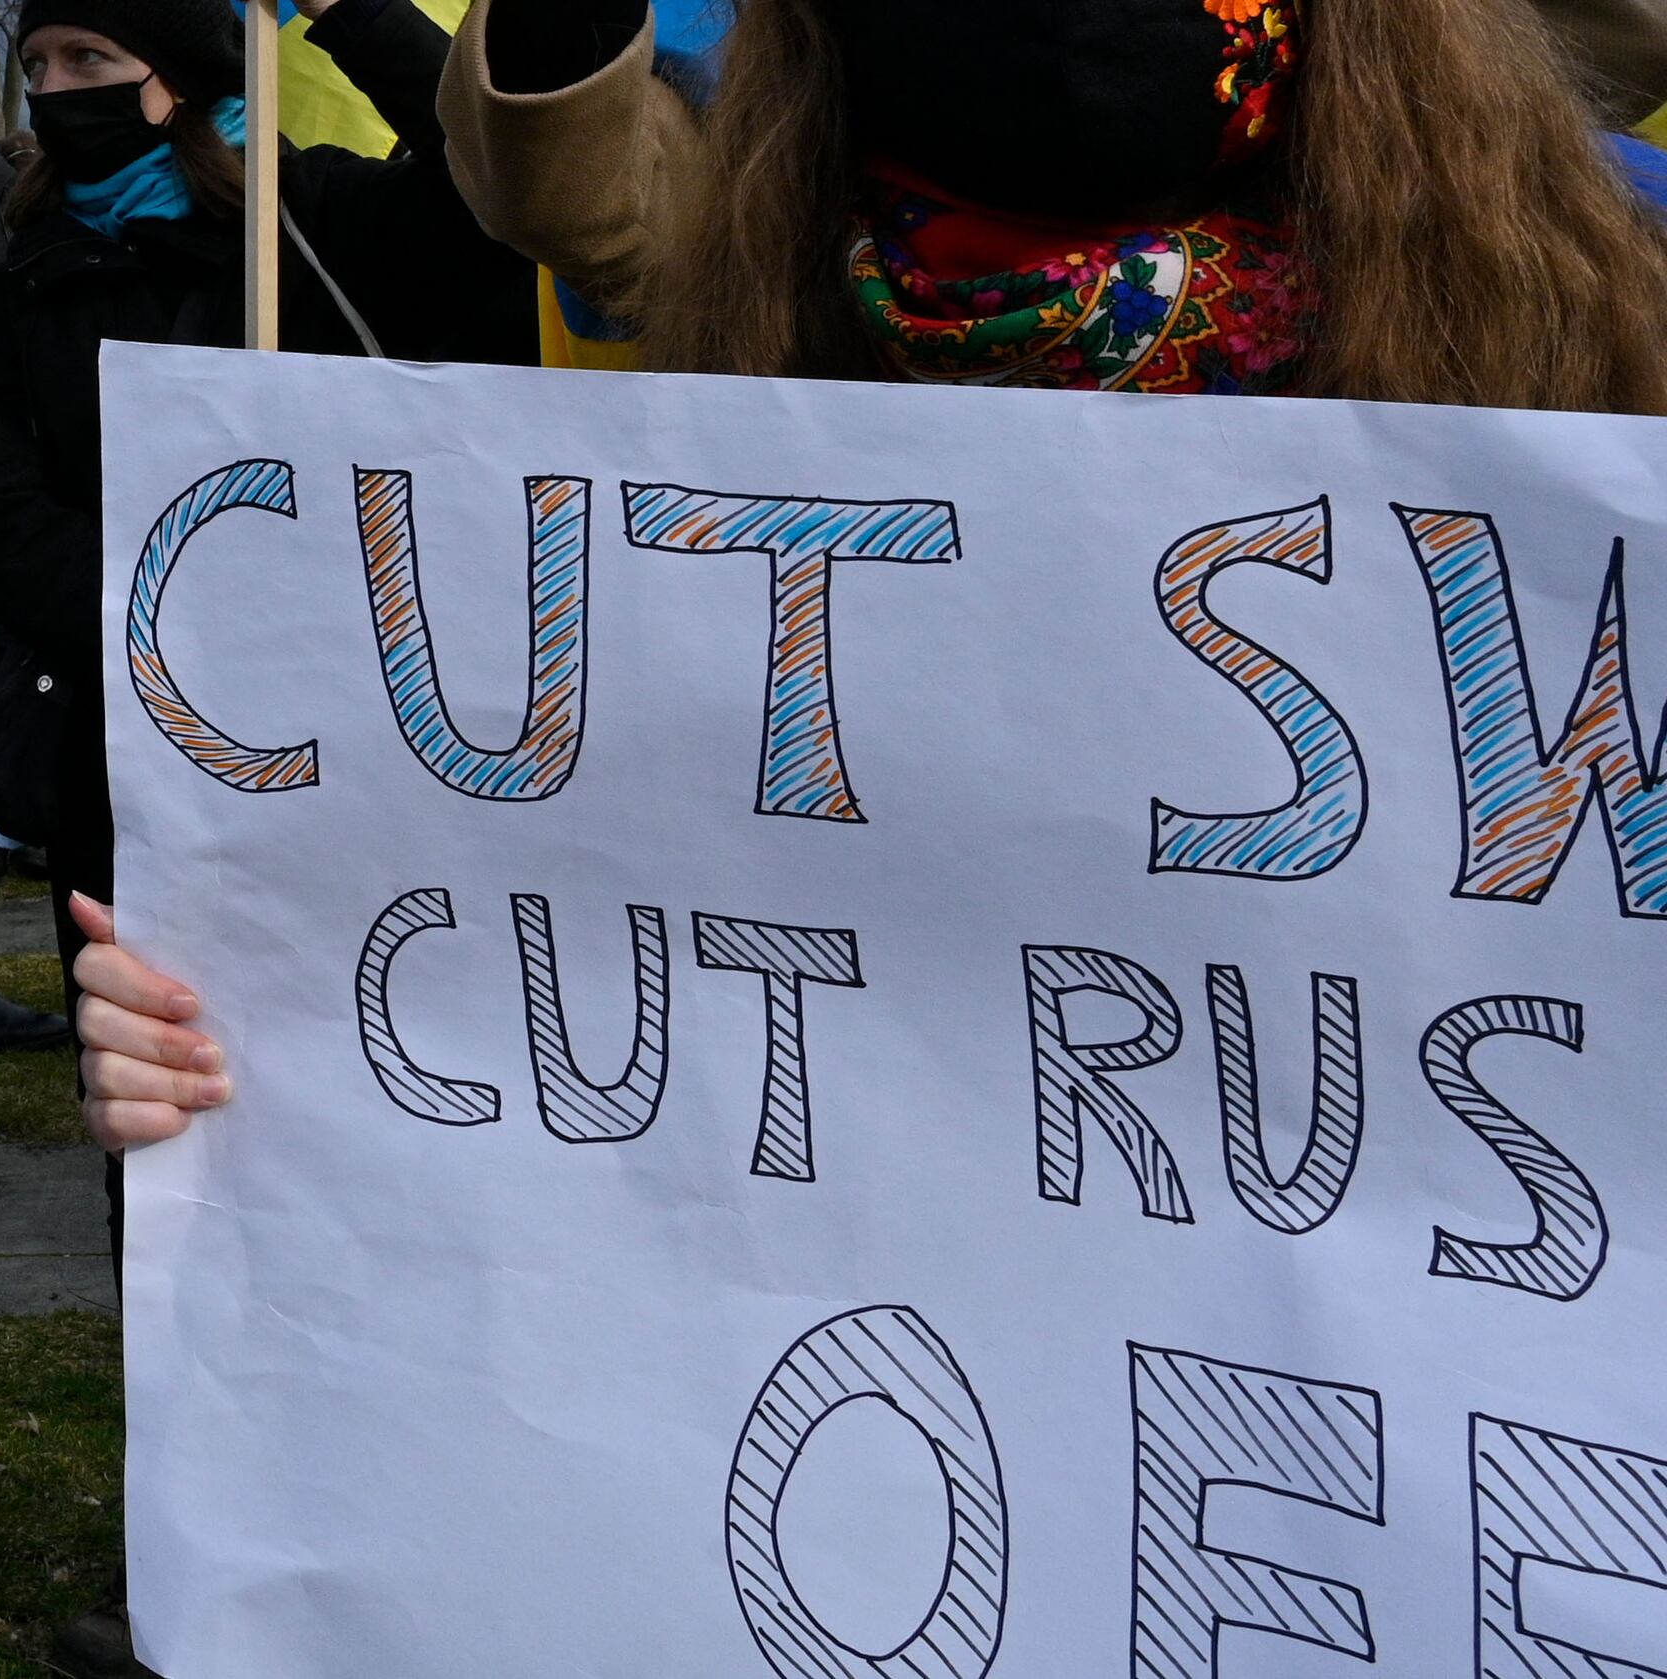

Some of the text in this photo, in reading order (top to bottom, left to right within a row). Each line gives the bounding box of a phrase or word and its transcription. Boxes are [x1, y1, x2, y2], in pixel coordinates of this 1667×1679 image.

[127, 459, 961, 823] CUT
[355, 889, 1609, 1302] CUT RUS
